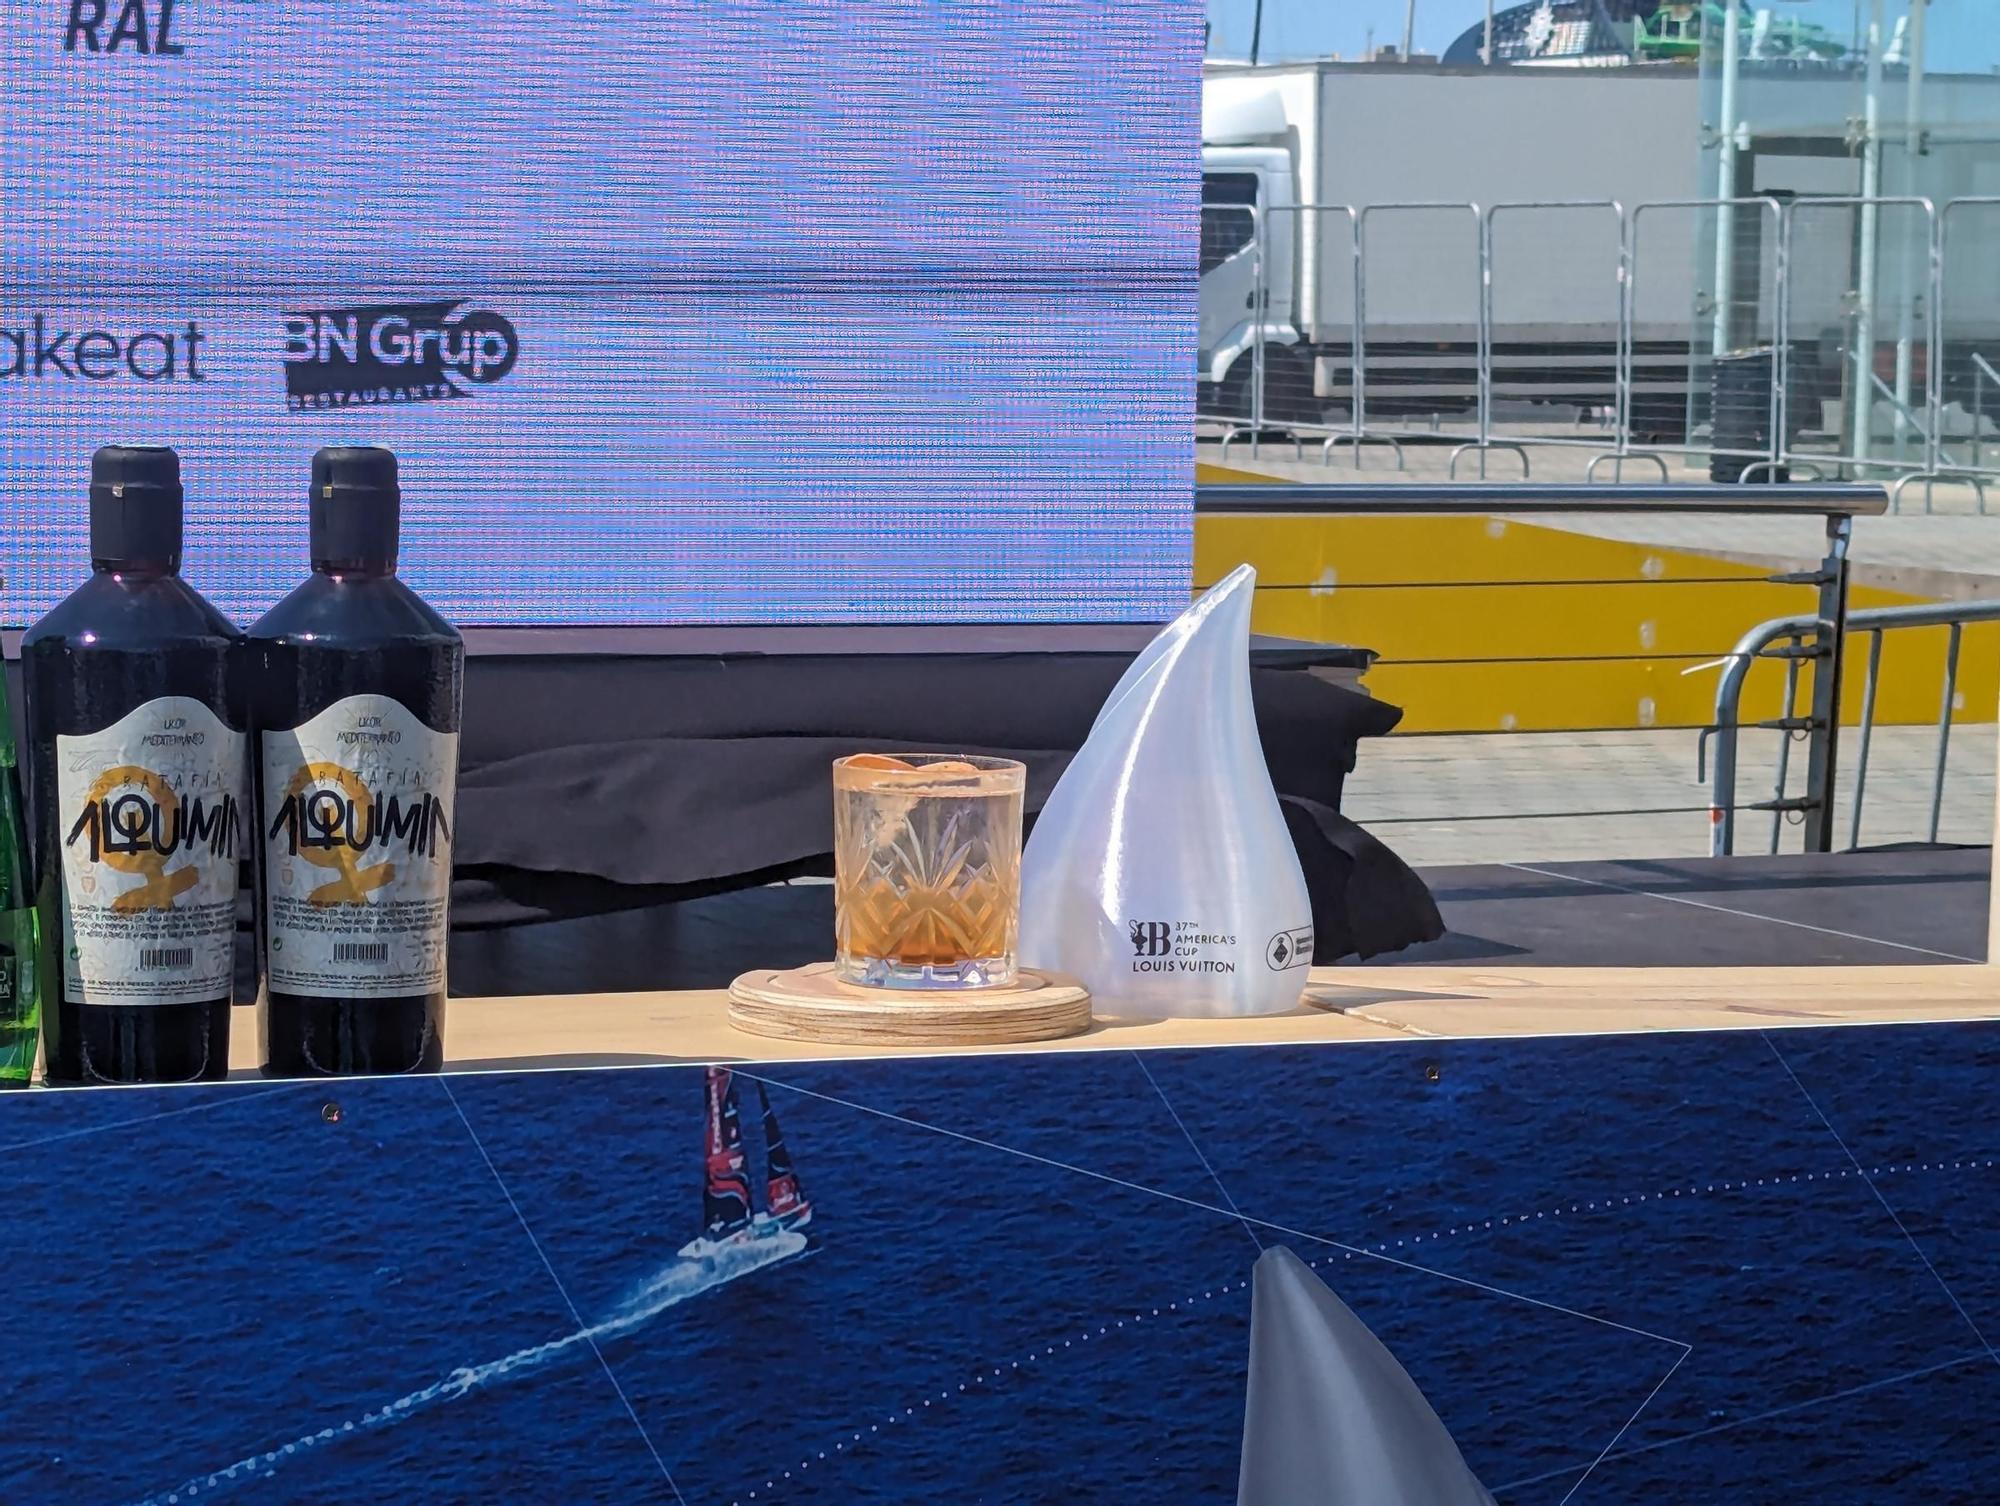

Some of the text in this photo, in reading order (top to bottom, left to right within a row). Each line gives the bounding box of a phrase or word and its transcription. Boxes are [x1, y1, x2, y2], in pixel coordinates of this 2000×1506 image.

[65, 0, 185, 54] RAL
[285, 313, 509, 378] BN Grup
[66, 793, 241, 863] ALQUIMIA
[269, 789, 450, 858] ALQUIMIA
[1174, 947, 1199, 956] CUP
[1175, 934, 1237, 945] AMERICA'S
[1132, 960, 1235, 974] LOUIS VUITTON
